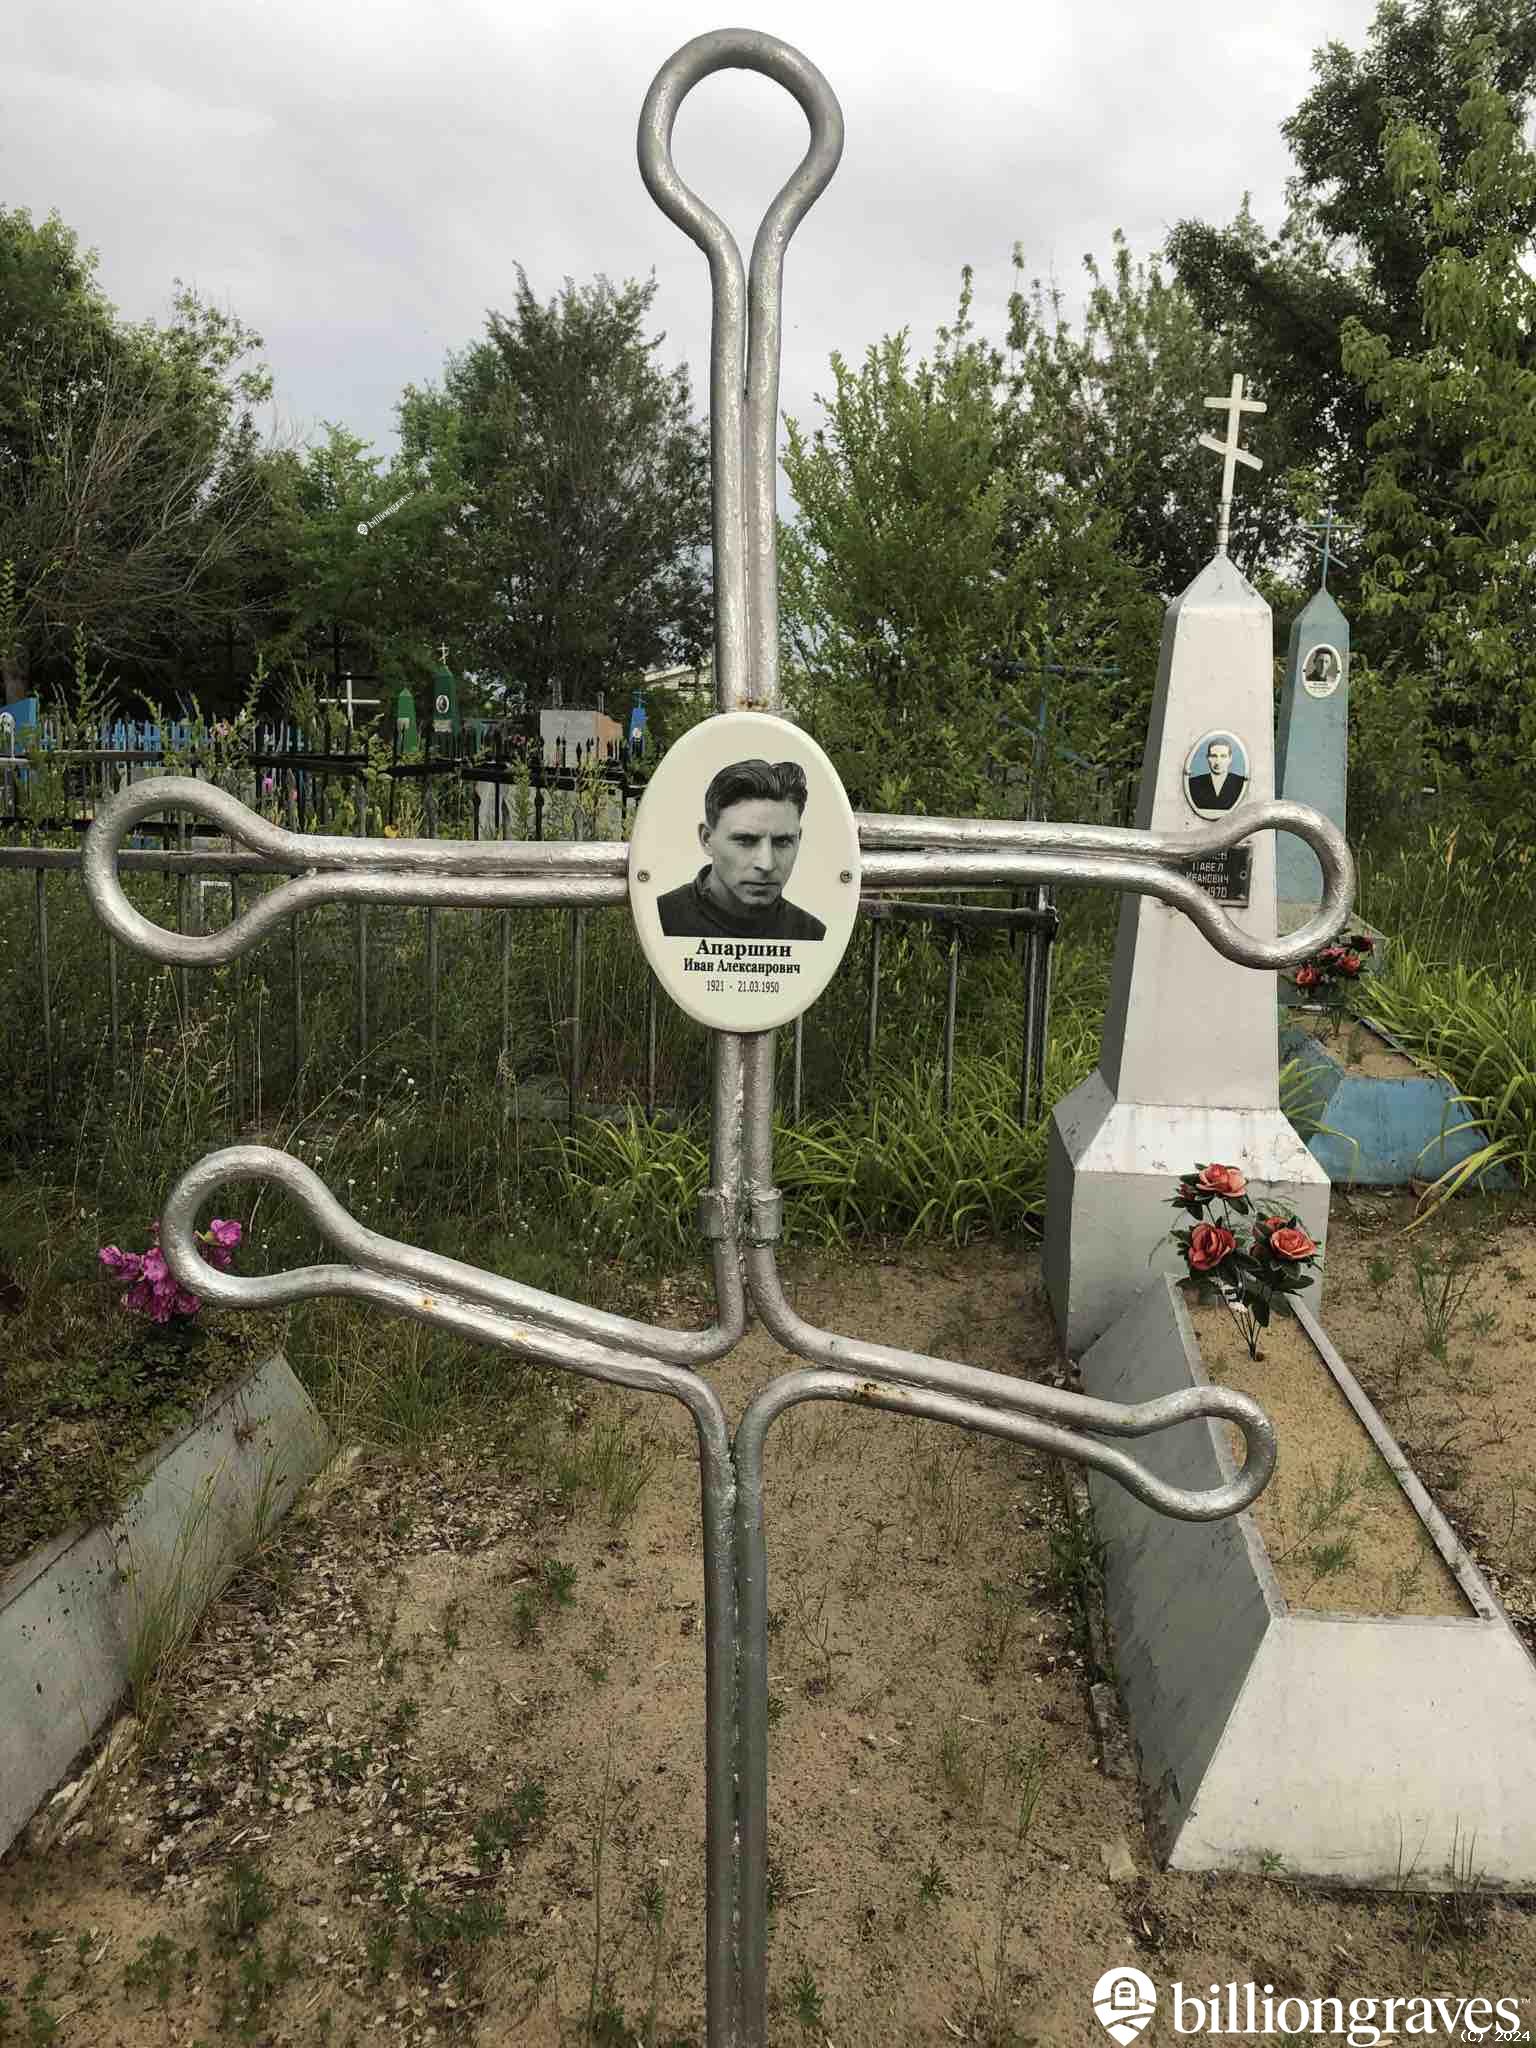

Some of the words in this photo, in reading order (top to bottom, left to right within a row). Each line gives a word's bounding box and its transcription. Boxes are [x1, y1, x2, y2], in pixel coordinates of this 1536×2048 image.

[695, 938, 793, 960] Апаршин
[683, 958, 714, 972] Иван
[716, 959, 801, 976] Алексанрович
[706, 980, 725, 992] 1921
[737, 980, 780, 993] 21.03.1950
